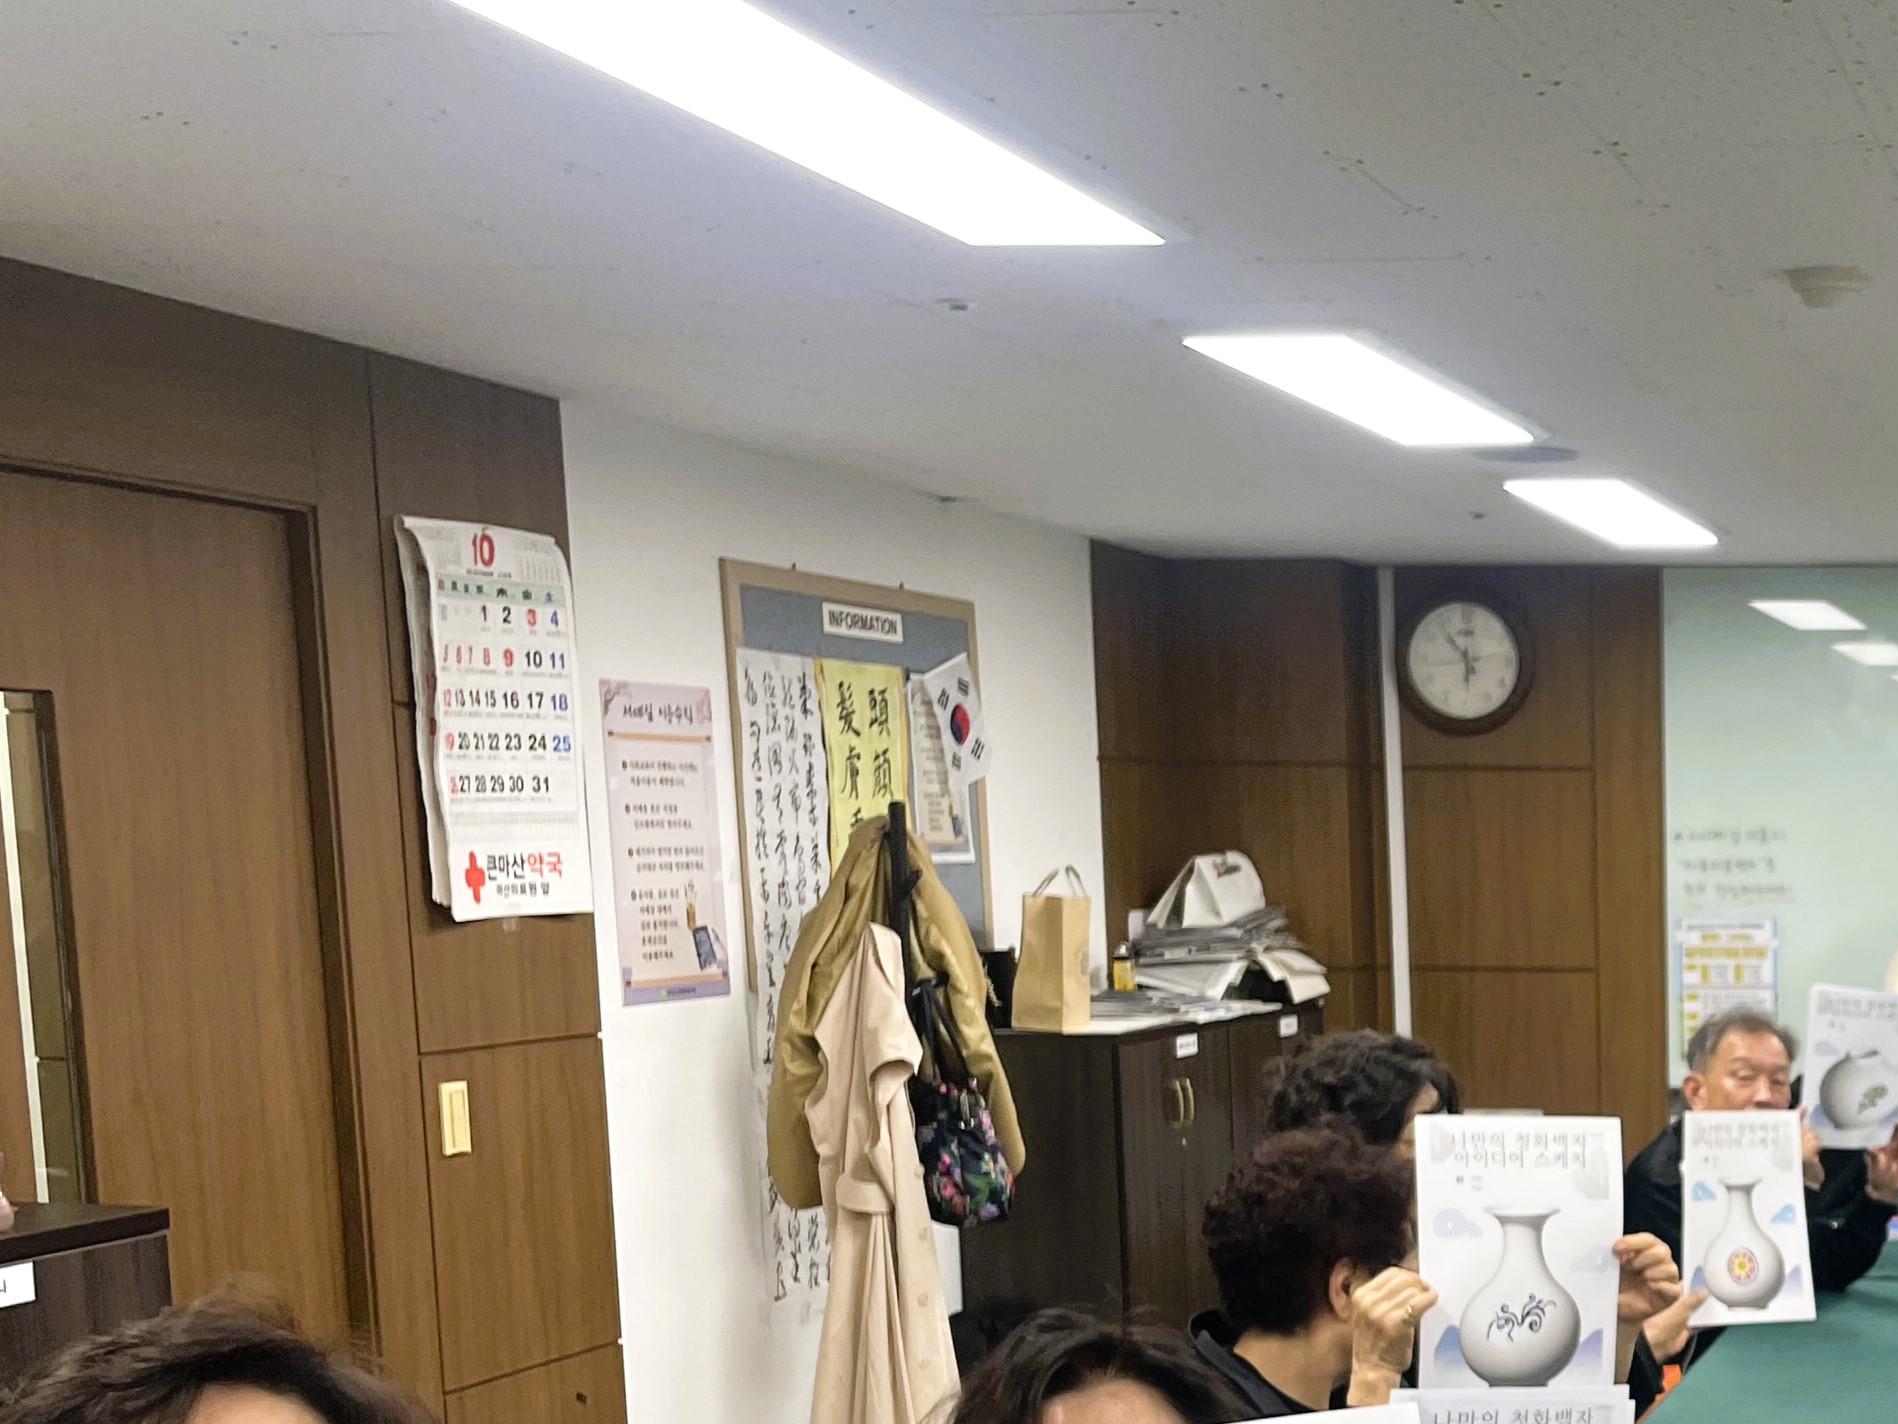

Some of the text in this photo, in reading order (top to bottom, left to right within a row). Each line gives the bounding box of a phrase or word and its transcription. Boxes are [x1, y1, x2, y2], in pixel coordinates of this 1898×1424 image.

[472, 532, 495, 567] 10
[481, 604, 559, 627] 1 2 3 4
[828, 609, 898, 635] INFORMATION
[456, 646, 462, 664] 6
[483, 648, 490, 666] 8
[503, 648, 513, 667] 9
[525, 650, 542, 668] 10
[550, 652, 565, 669] 11
[444, 689, 568, 711] 12 13 14 15 16 17 18
[458, 732, 470, 750] 20
[474, 732, 485, 750] 21
[488, 732, 500, 750] 22
[505, 733, 522, 751] 23
[528, 734, 547, 751] 24
[552, 735, 571, 752] 25
[459, 775, 471, 793] 27
[475, 775, 487, 793] 28
[491, 775, 505, 793] 29
[509, 775, 524, 793] 30
[532, 776, 550, 793] 31
[1454, 1148, 1524, 1168] 아이디어
